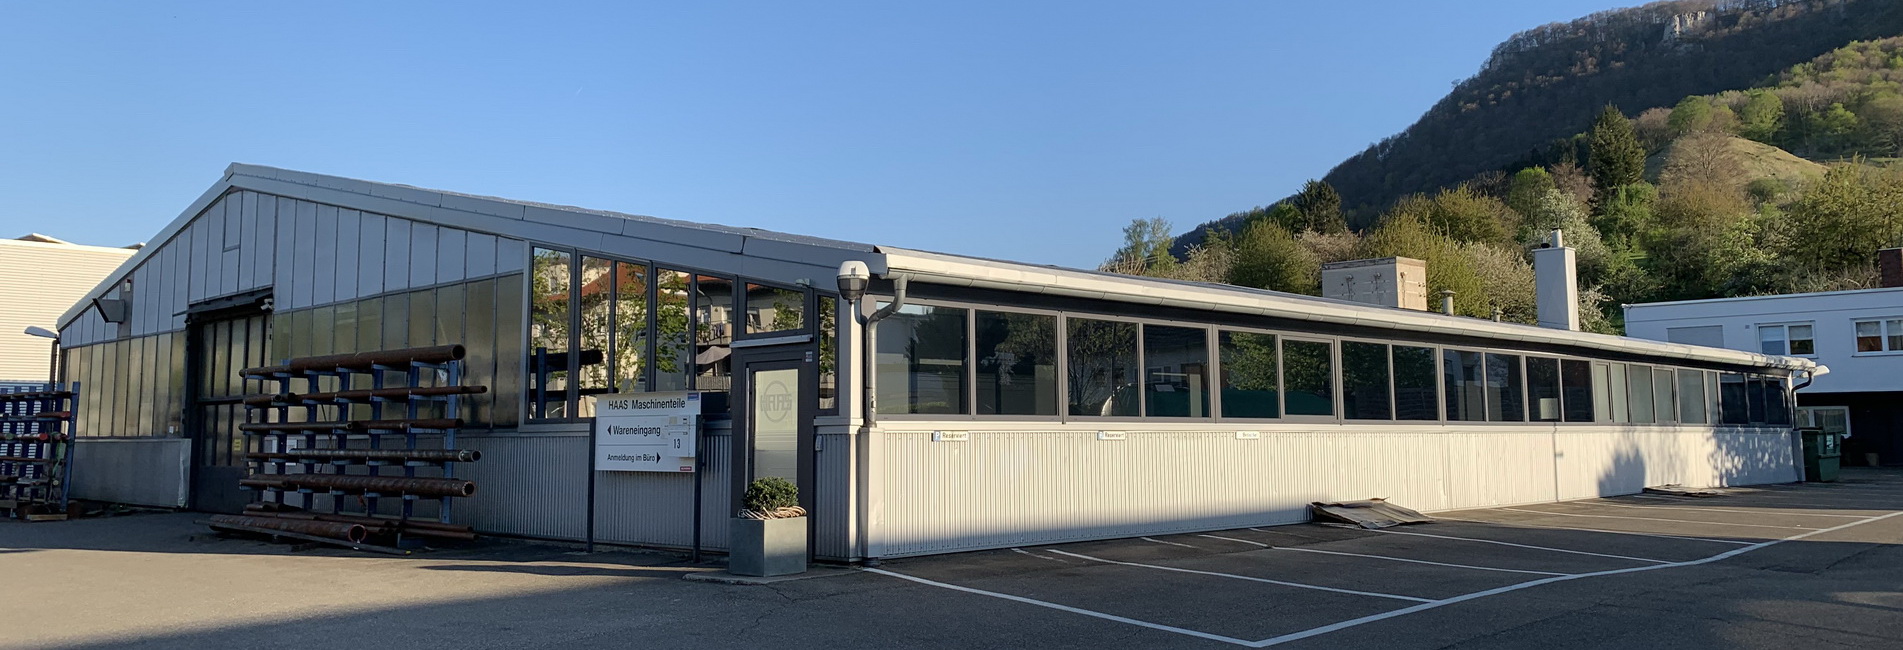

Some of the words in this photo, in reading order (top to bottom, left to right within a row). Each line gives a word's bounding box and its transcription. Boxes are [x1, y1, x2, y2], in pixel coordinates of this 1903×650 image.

[608, 399, 628, 410] HAAS
[631, 398, 686, 410] Maschinenteile
[761, 394, 793, 411] HAAS
[613, 425, 661, 437] Wareneingang
[673, 438, 681, 449] 13
[607, 454, 635, 463] Anmeldung
[636, 454, 642, 462] im
[643, 453, 656, 462] Büro
